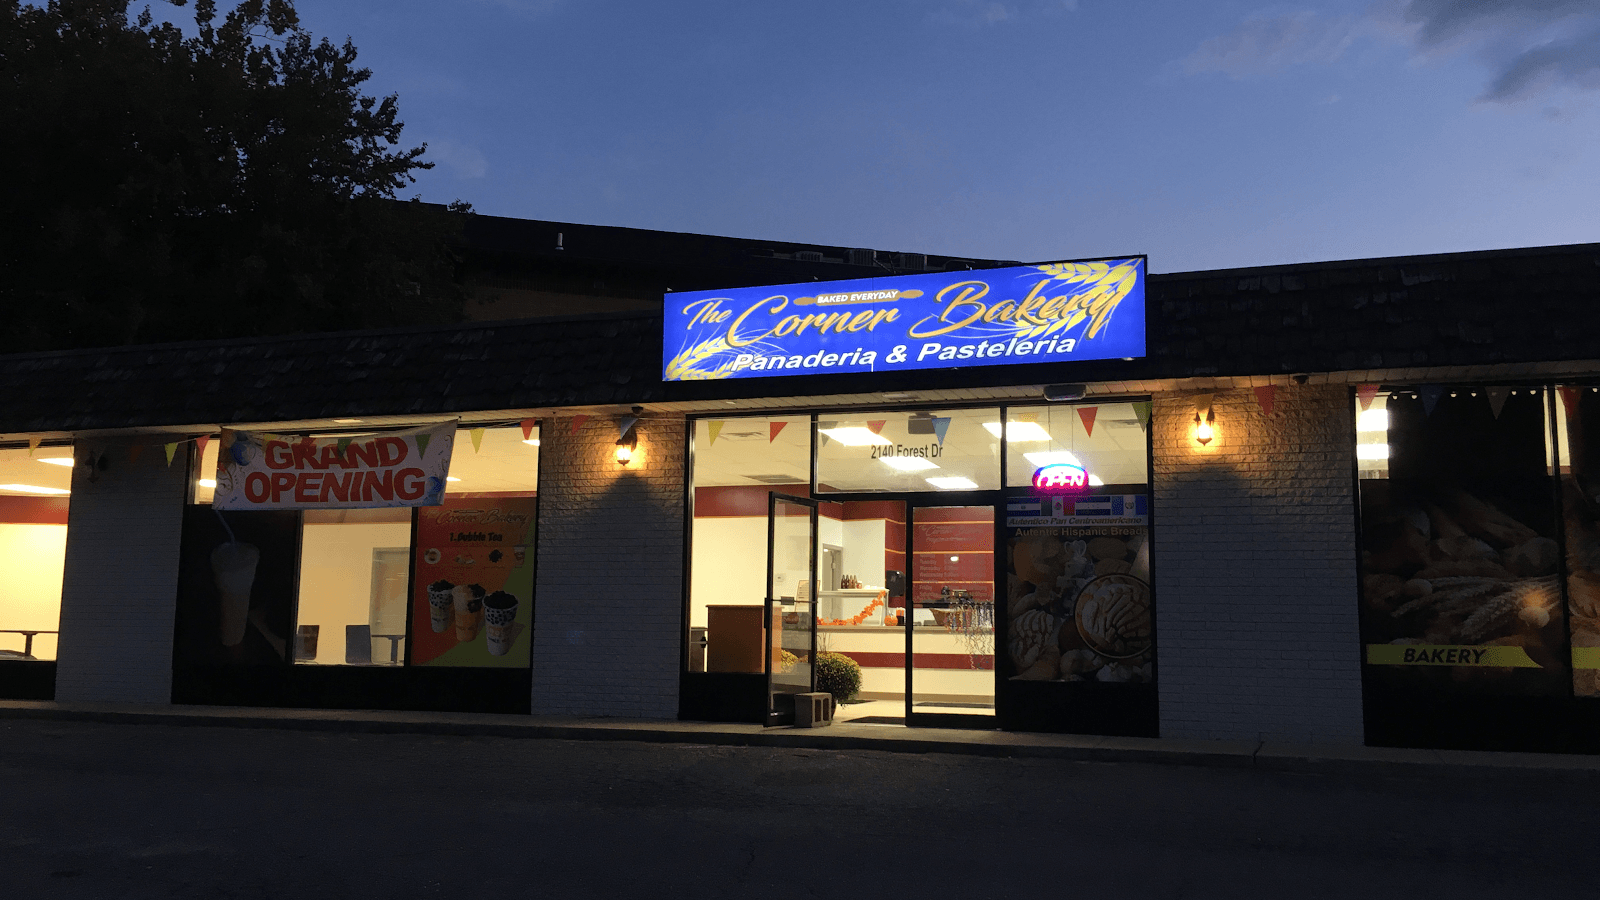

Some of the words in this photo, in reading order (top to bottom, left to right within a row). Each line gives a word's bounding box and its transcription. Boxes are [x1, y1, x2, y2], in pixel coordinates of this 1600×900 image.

[817, 292, 848, 304] BAKED
[850, 290, 899, 302] EVERYDAY
[682, 297, 734, 330] The
[725, 295, 902, 347] Corner
[907, 279, 1124, 341] Bakery
[729, 347, 878, 373] Panaderia
[885, 344, 908, 364] &
[916, 334, 1077, 363] Pasteleria
[264, 436, 409, 470] GRAND
[871, 444, 894, 459] 2140
[896, 444, 929, 458] Forest
[931, 443, 944, 458] Dr
[244, 467, 426, 504] OPENING
[1037, 469, 1085, 487] OPEN
[1050, 517, 1067, 525] Pan
[488, 531, 503, 542] Tea
[1015, 527, 1058, 537] Autentic
[1061, 526, 1107, 538] Hispanic
[1110, 526, 1149, 536] Breads
[1403, 648, 1486, 665] BAKERY
